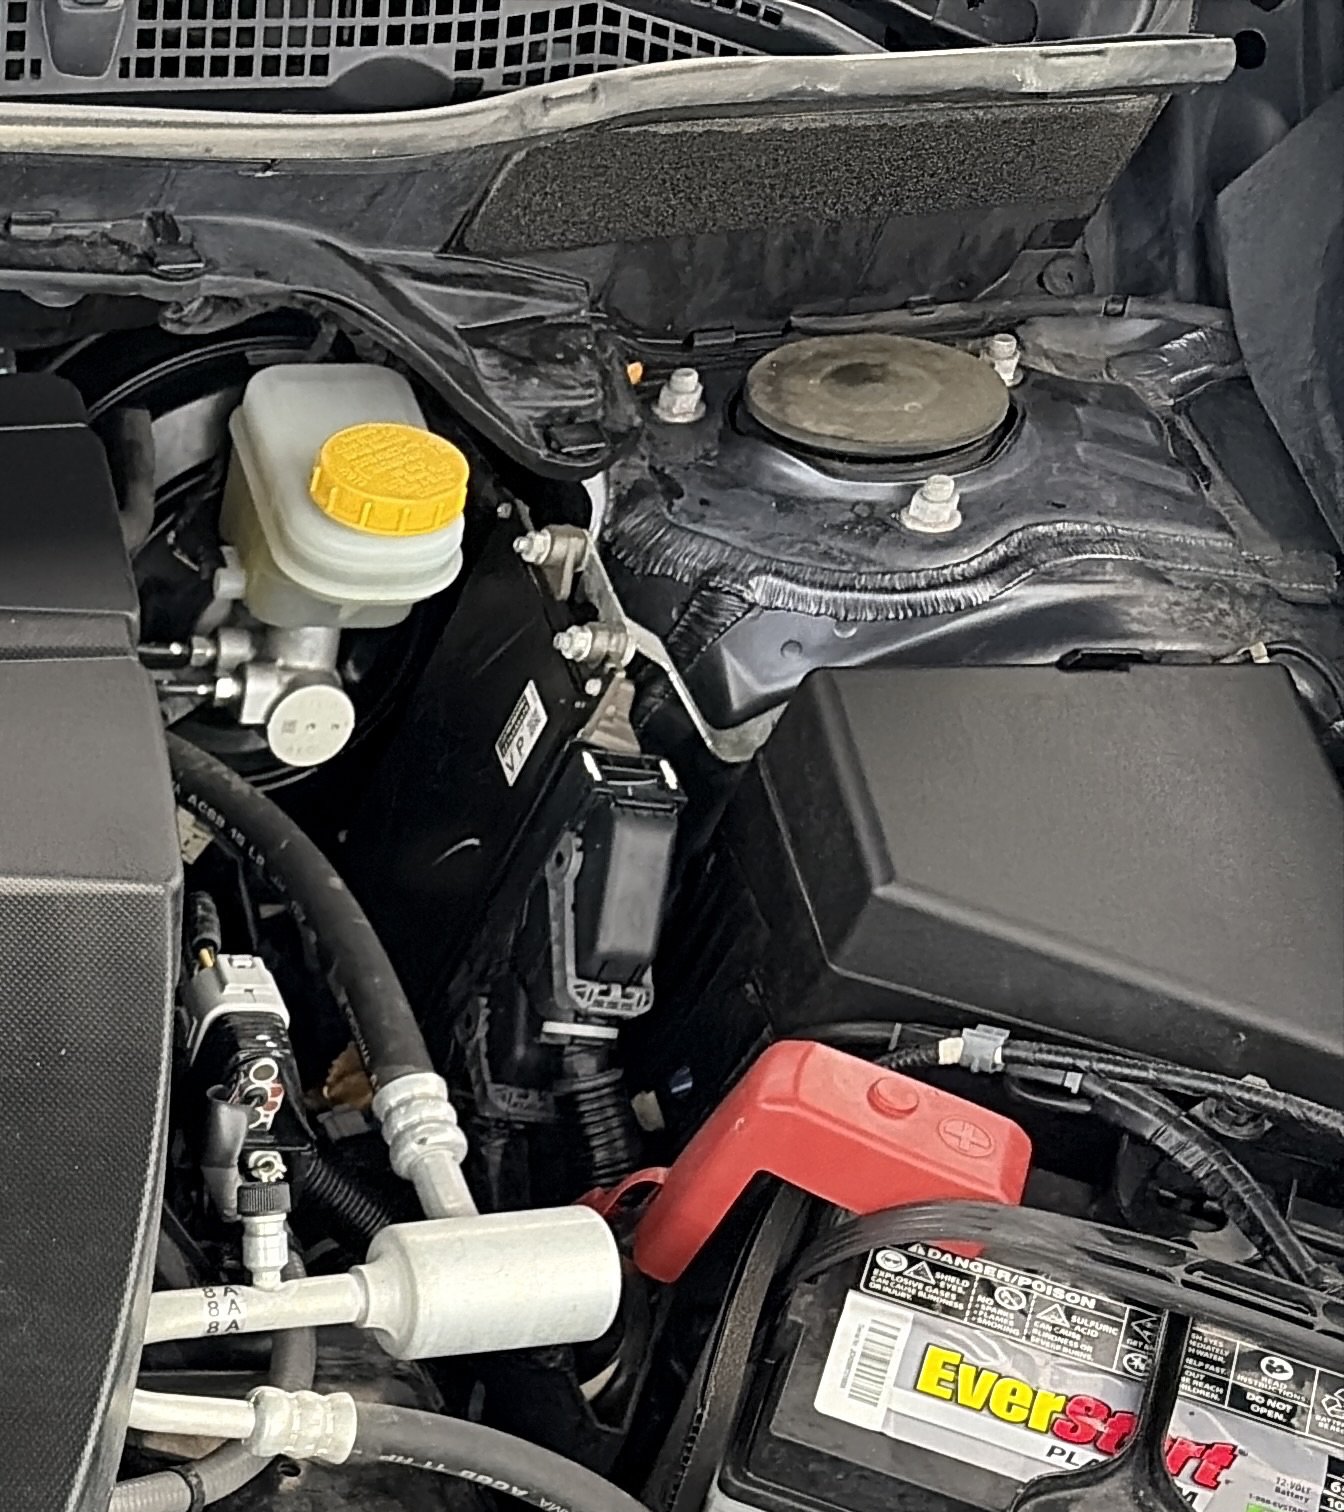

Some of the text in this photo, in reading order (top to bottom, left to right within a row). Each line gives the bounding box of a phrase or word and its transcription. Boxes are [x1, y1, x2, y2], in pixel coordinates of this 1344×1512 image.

[868, 1281, 883, 1291] OR
[872, 1268, 958, 1301] EXPLOSIVE GASES
[927, 1248, 1096, 1310] DANGER/POISON
[934, 1271, 971, 1289] SHIELD
[871, 1275, 964, 1311] CAN CAUSE BLINDNESS
[977, 1295, 995, 1306] NO
[208, 1298, 242, 1317] 8 A
[206, 1318, 240, 1334] 8 A
[976, 1317, 1020, 1337] SMOKING
[1033, 1320, 1082, 1341] CAN CAUSE
[1070, 1315, 1120, 1336] SULFURIC
[1074, 1325, 1100, 1339] ACID
[1030, 1335, 1063, 1351] SEVERE
[1031, 1328, 1094, 1354] BLINDNESS OR
[1204, 1336, 1225, 1348] EYES
[1184, 1370, 1206, 1381] OUT
[1261, 1376, 1288, 1390] READ
[1192, 1378, 1224, 1395] REACH
[1246, 1391, 1293, 1414] DO NOT
[1250, 1404, 1288, 1423] OPEN.
[1274, 1486, 1310, 1504] Battery
